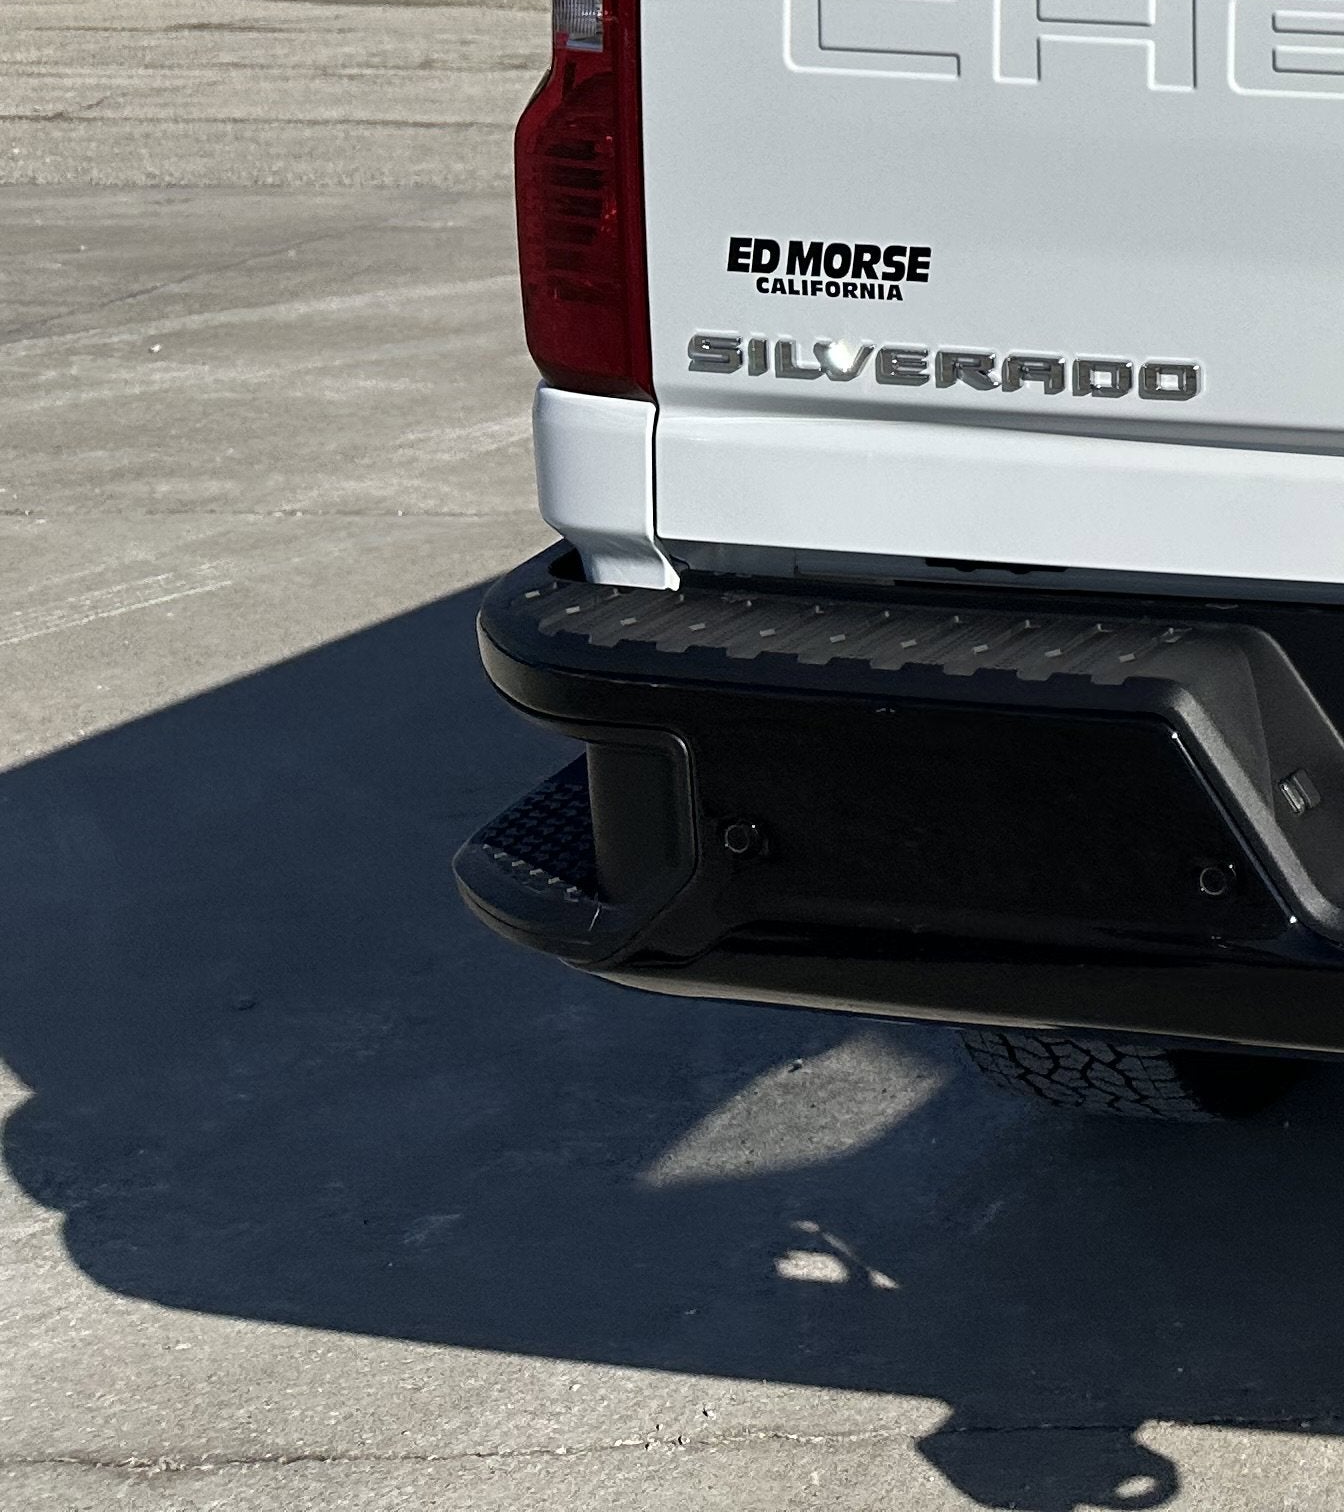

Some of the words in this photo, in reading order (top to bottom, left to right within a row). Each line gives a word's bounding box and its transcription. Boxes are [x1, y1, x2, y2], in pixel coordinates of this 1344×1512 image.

[727, 237, 780, 274] ED
[786, 240, 932, 283] MORSE
[756, 276, 904, 301] CALIFORNIA
[687, 331, 1203, 402] SILVERADO
